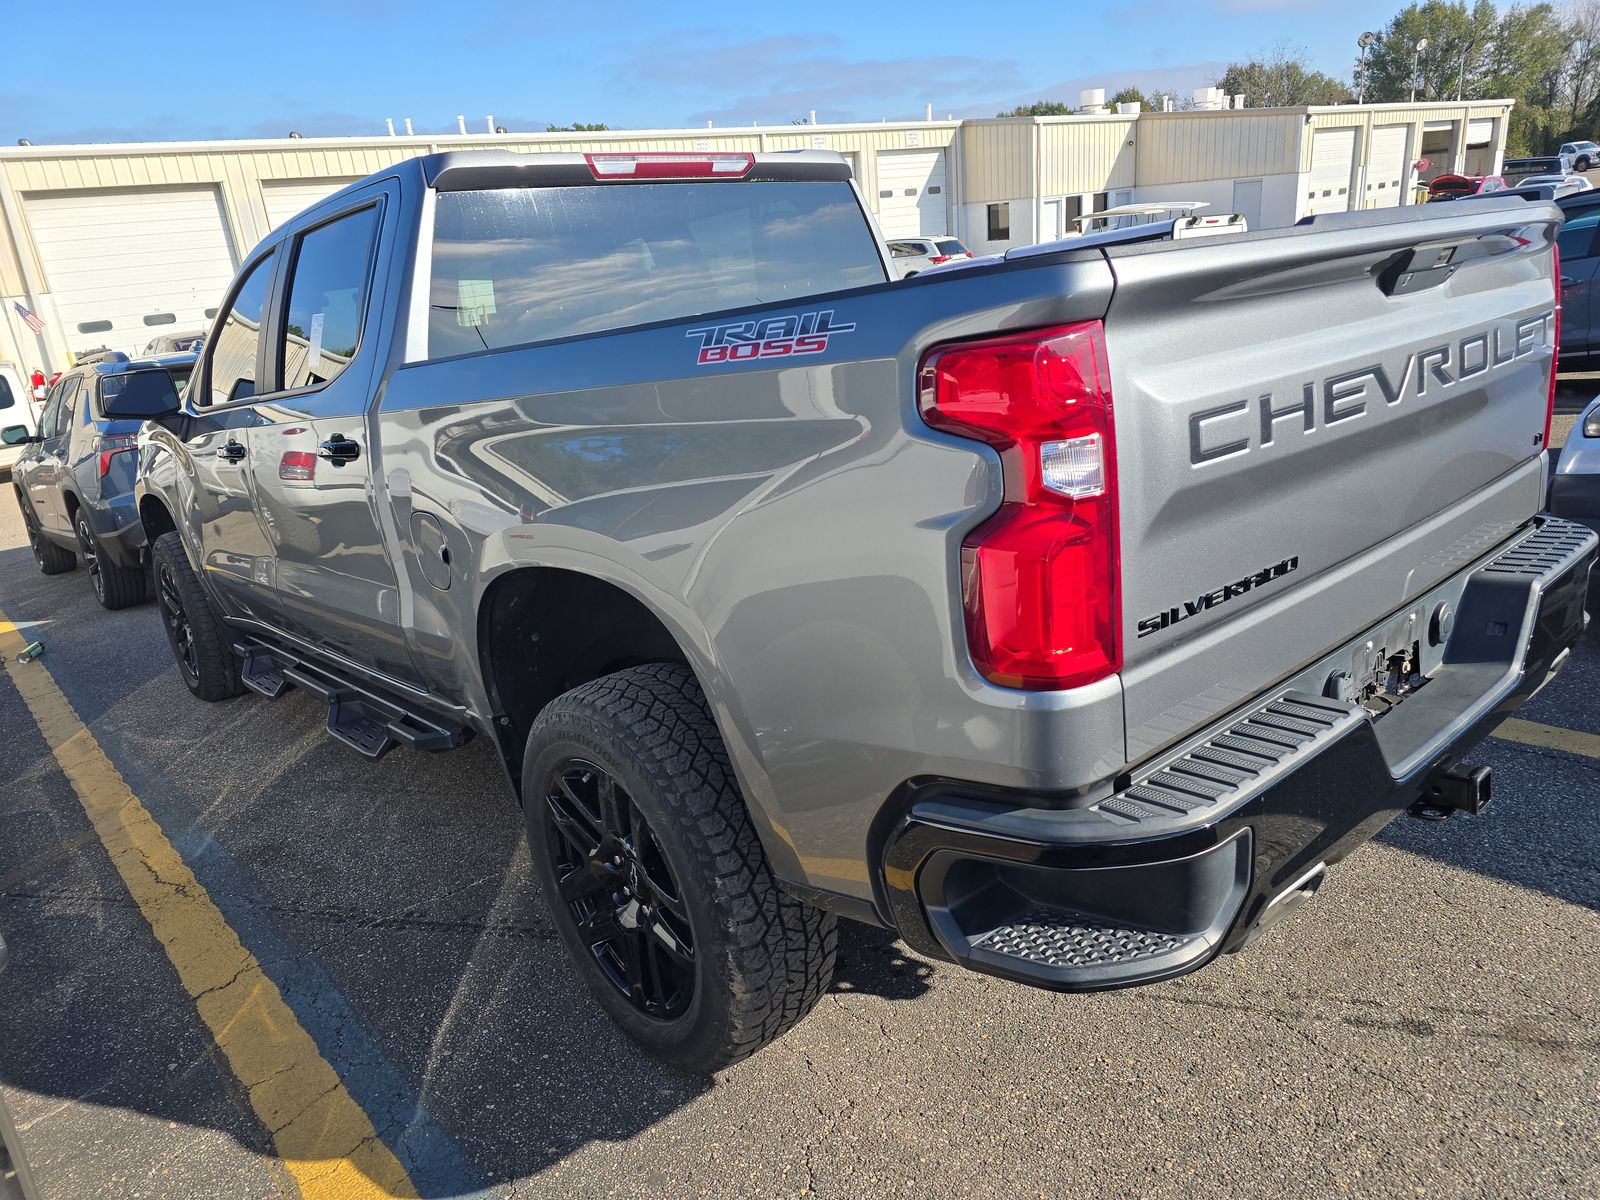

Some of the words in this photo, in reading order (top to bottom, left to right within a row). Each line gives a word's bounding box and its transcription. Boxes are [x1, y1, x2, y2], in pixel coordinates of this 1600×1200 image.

[685, 310, 856, 347] TRAIL
[697, 333, 829, 365] BOSS
[1189, 311, 1553, 469] CHEVROLET
[1138, 556, 1298, 638] SILVERADO
